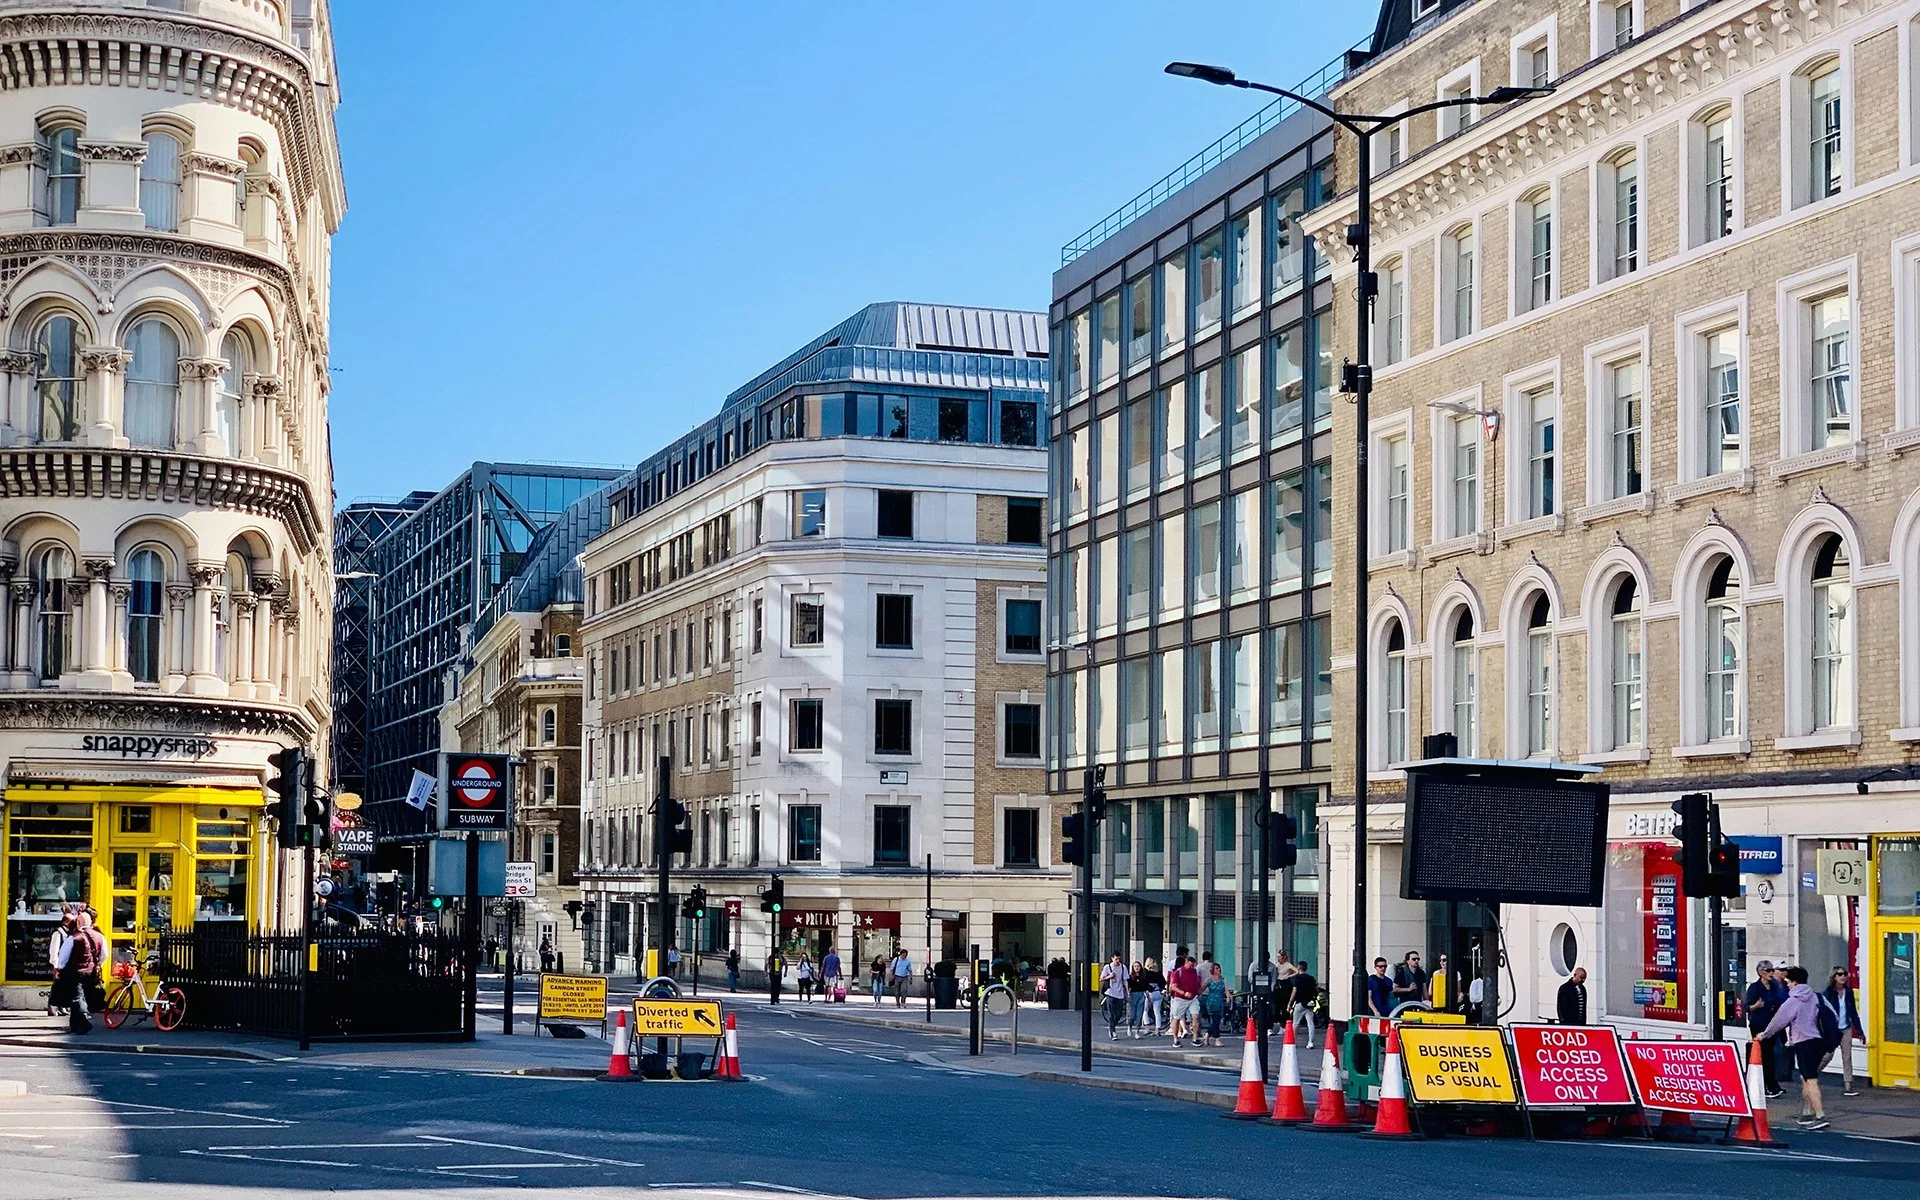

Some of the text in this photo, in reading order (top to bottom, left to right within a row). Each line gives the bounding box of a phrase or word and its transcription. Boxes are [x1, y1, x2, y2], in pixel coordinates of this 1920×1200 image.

[82, 735, 218, 759] snappysnaps
[451, 780, 502, 788] UNDERGROUND
[459, 815, 495, 823] SUBWAY
[1626, 813, 1682, 836] BETFR
[338, 830, 374, 843] VAPE
[337, 843, 373, 852] STATION
[805, 912, 823, 926] PRET
[825, 913, 830, 926] A
[638, 1006, 688, 1017] Diverted
[646, 1019, 683, 1029] traffic
[1540, 1031, 1587, 1046] ROAD
[1419, 1045, 1492, 1058] BUSINESS
[1536, 1049, 1601, 1064] CLOSED
[1636, 1047, 1725, 1062] NO THROUGH
[1438, 1060, 1479, 1073] OPEN
[1662, 1063, 1706, 1077] ROUTE
[1426, 1074, 1501, 1088] AS USUAL
[1539, 1067, 1608, 1082] ACCESS
[1654, 1076, 1722, 1092] RESIDENTS
[1554, 1085, 1598, 1100] ONLY
[1649, 1089, 1736, 1107] ACCESS ONLY
